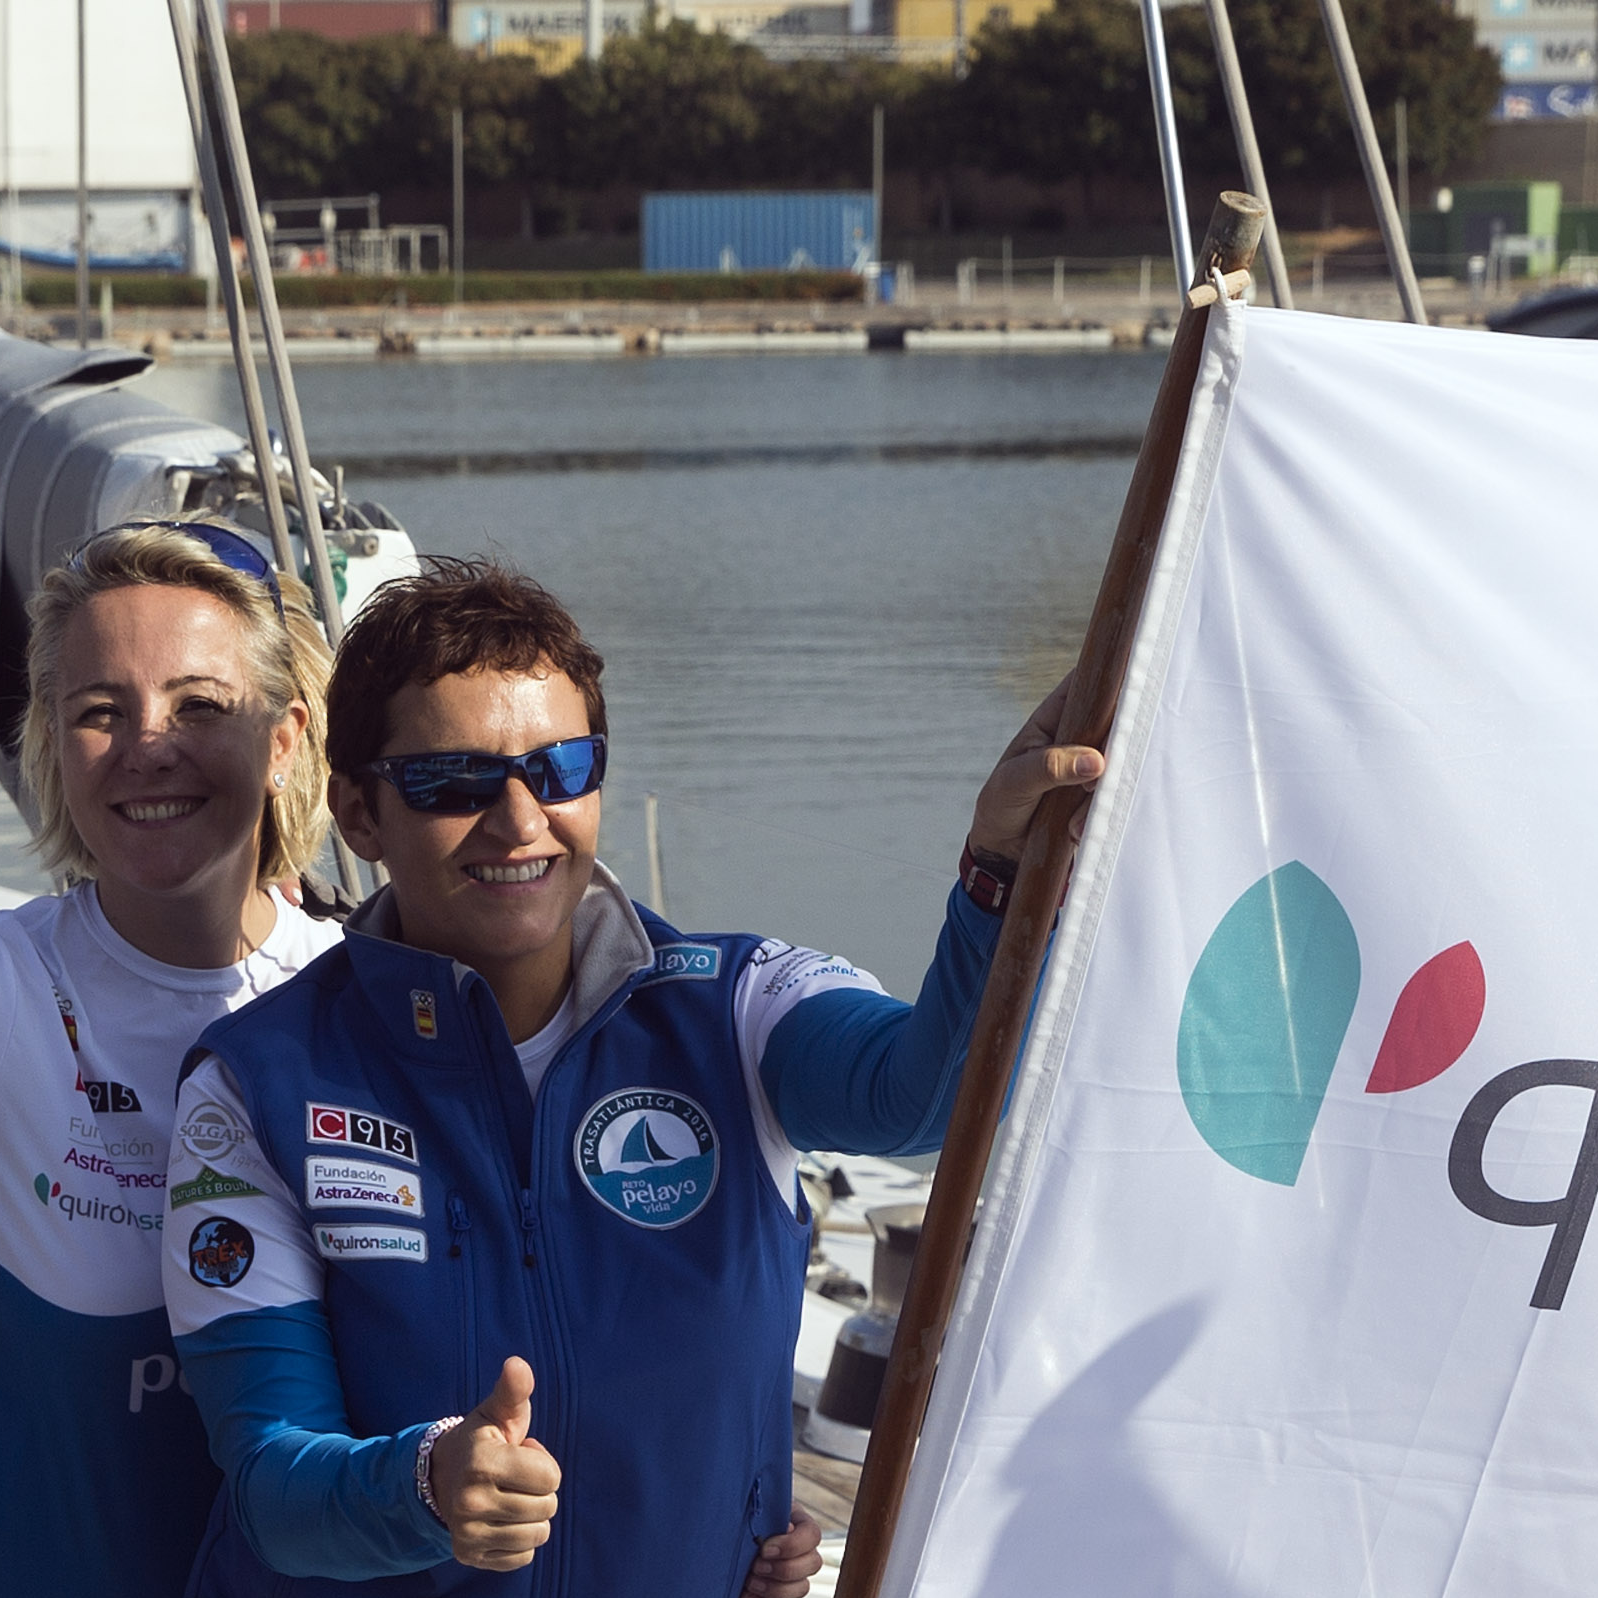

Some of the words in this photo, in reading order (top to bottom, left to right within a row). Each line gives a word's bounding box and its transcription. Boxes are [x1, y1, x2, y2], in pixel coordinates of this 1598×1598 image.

[178, 1124, 246, 1144] SOLGAR
[315, 1113, 406, 1153] C95
[584, 1095, 675, 1166] TRASATLÁNTICA
[682, 1106, 710, 1142] 2016
[314, 1165, 387, 1183] Fundación
[314, 1186, 400, 1204] AstraZeneca
[621, 1179, 697, 1210] pelayo
[642, 1202, 671, 1214] vida
[333, 1236, 421, 1254] quirónsalud
